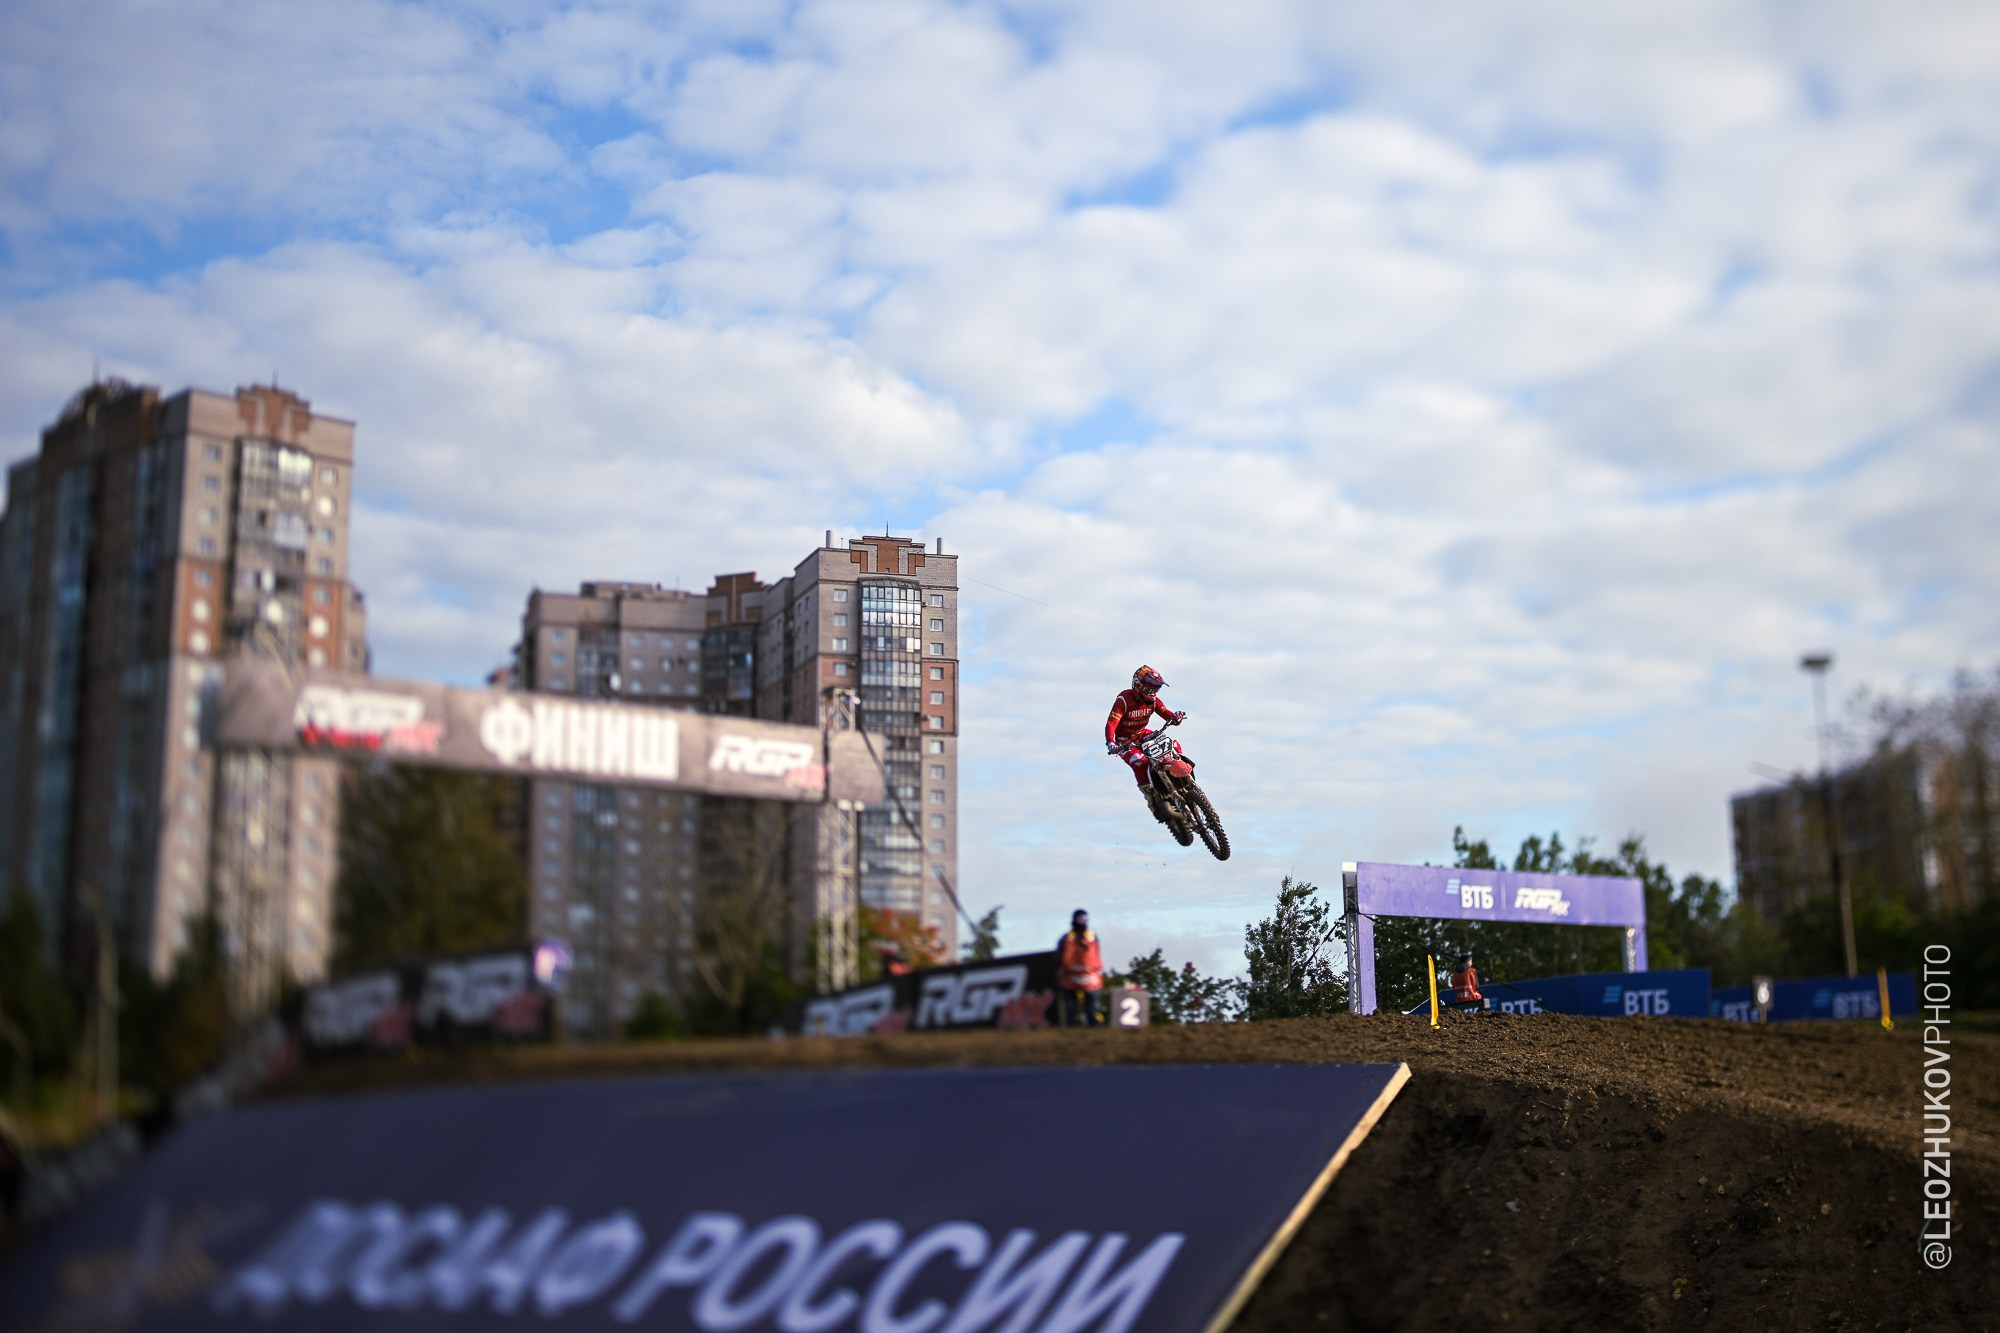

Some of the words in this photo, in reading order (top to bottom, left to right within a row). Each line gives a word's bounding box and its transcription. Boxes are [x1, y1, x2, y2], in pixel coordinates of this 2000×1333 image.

[480, 697, 681, 783] ФИНИШ
[708, 734, 815, 777] RGP
[1460, 884, 1495, 910] ВТБ
[1514, 886, 1563, 910] RGP
[915, 965, 1029, 1027] RGP
[1120, 997, 1141, 1026] 2
[1624, 989, 1670, 1015] ВТБ
[610, 1211, 1187, 1332] РОССИИ
